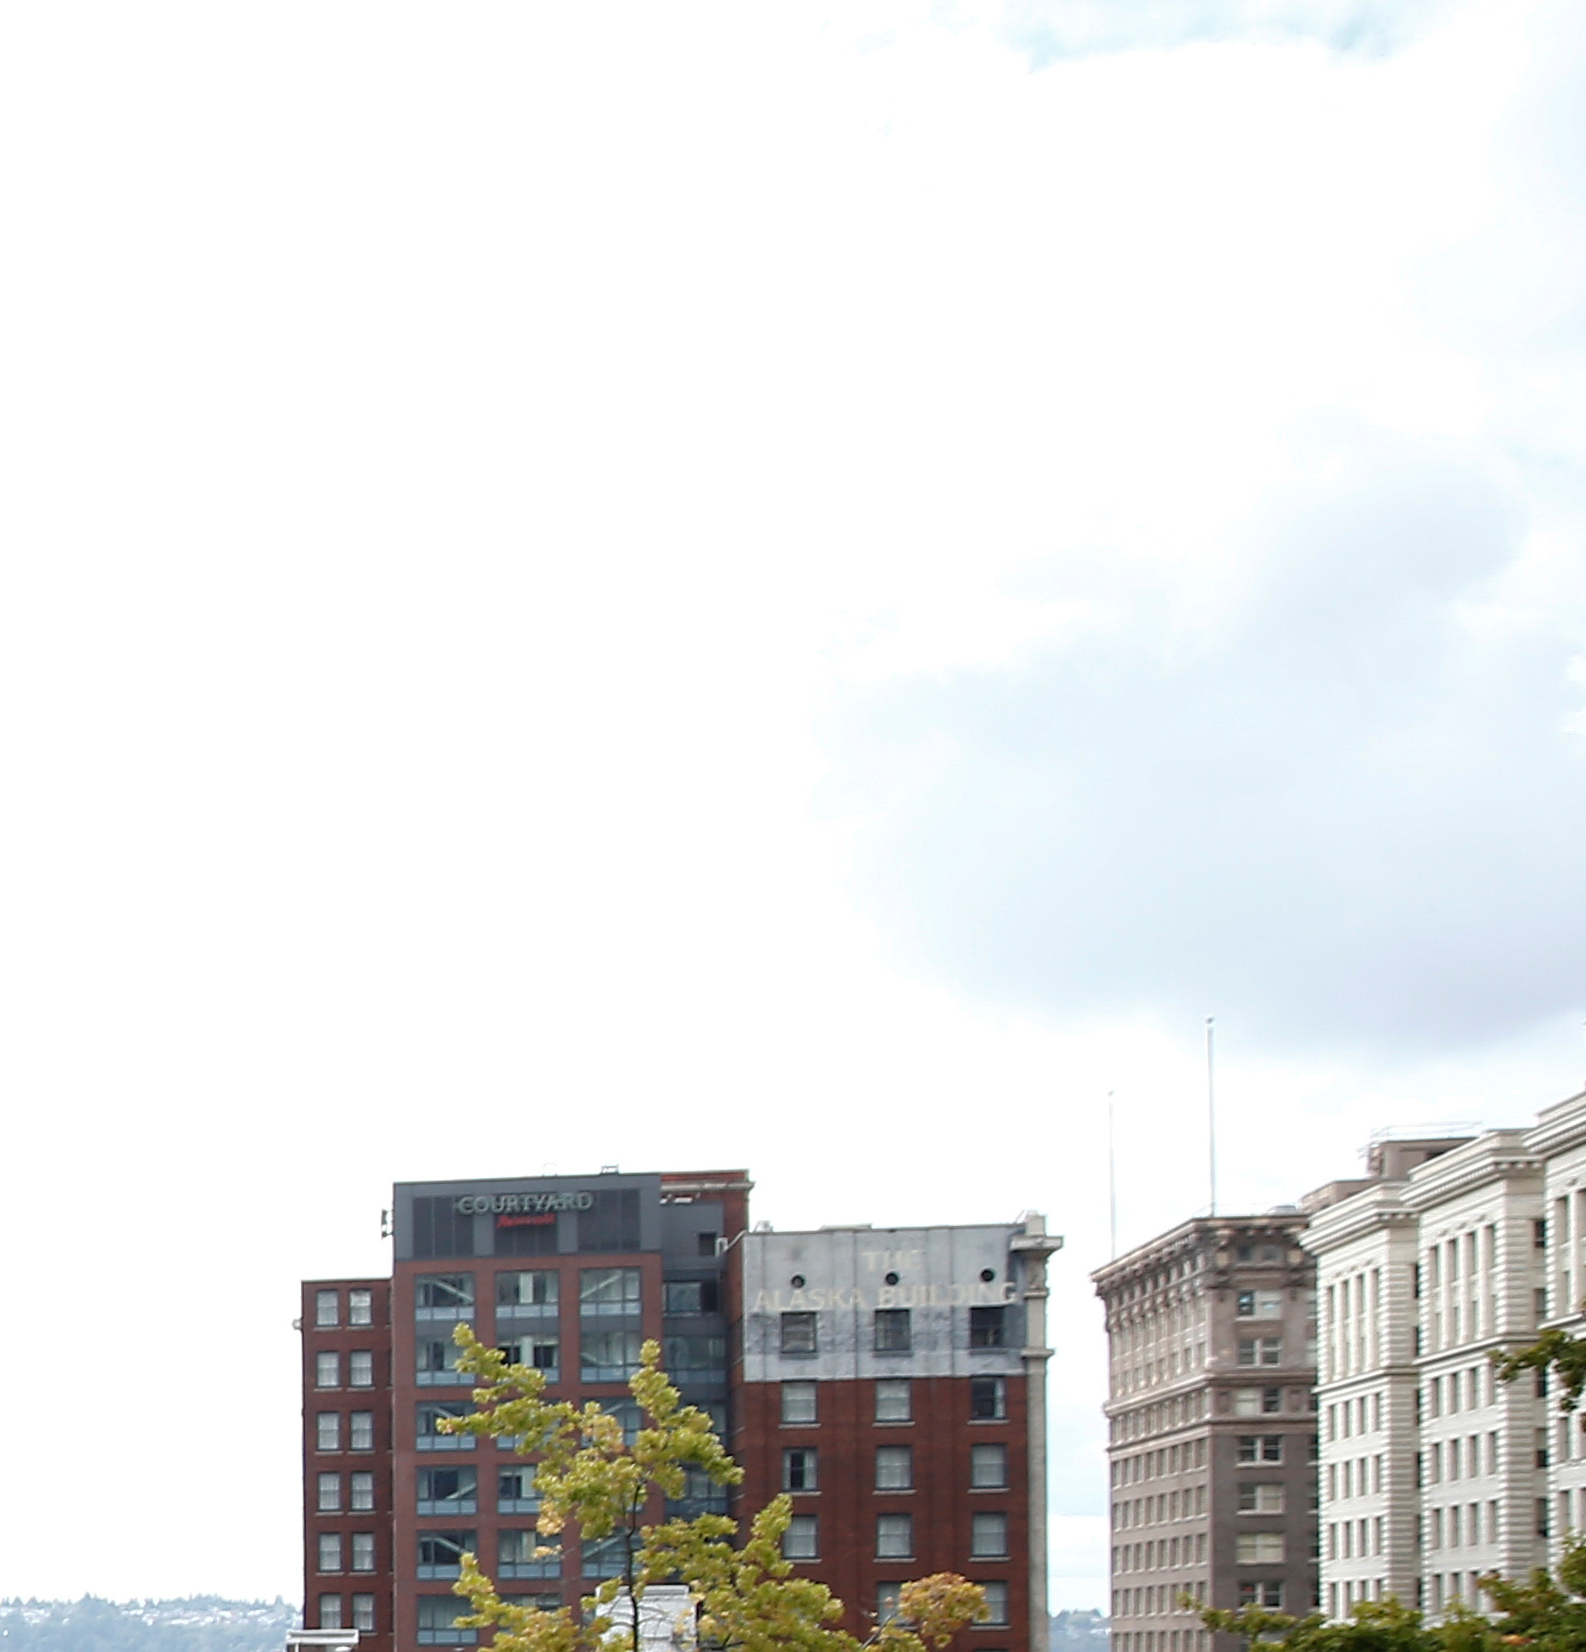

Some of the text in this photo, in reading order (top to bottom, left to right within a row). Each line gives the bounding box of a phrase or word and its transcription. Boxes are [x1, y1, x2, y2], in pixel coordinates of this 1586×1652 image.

[457, 1192, 593, 1215] COURTYARD
[862, 1250, 924, 1271] THE
[754, 1282, 1018, 1311] ALASKA BUILDING
